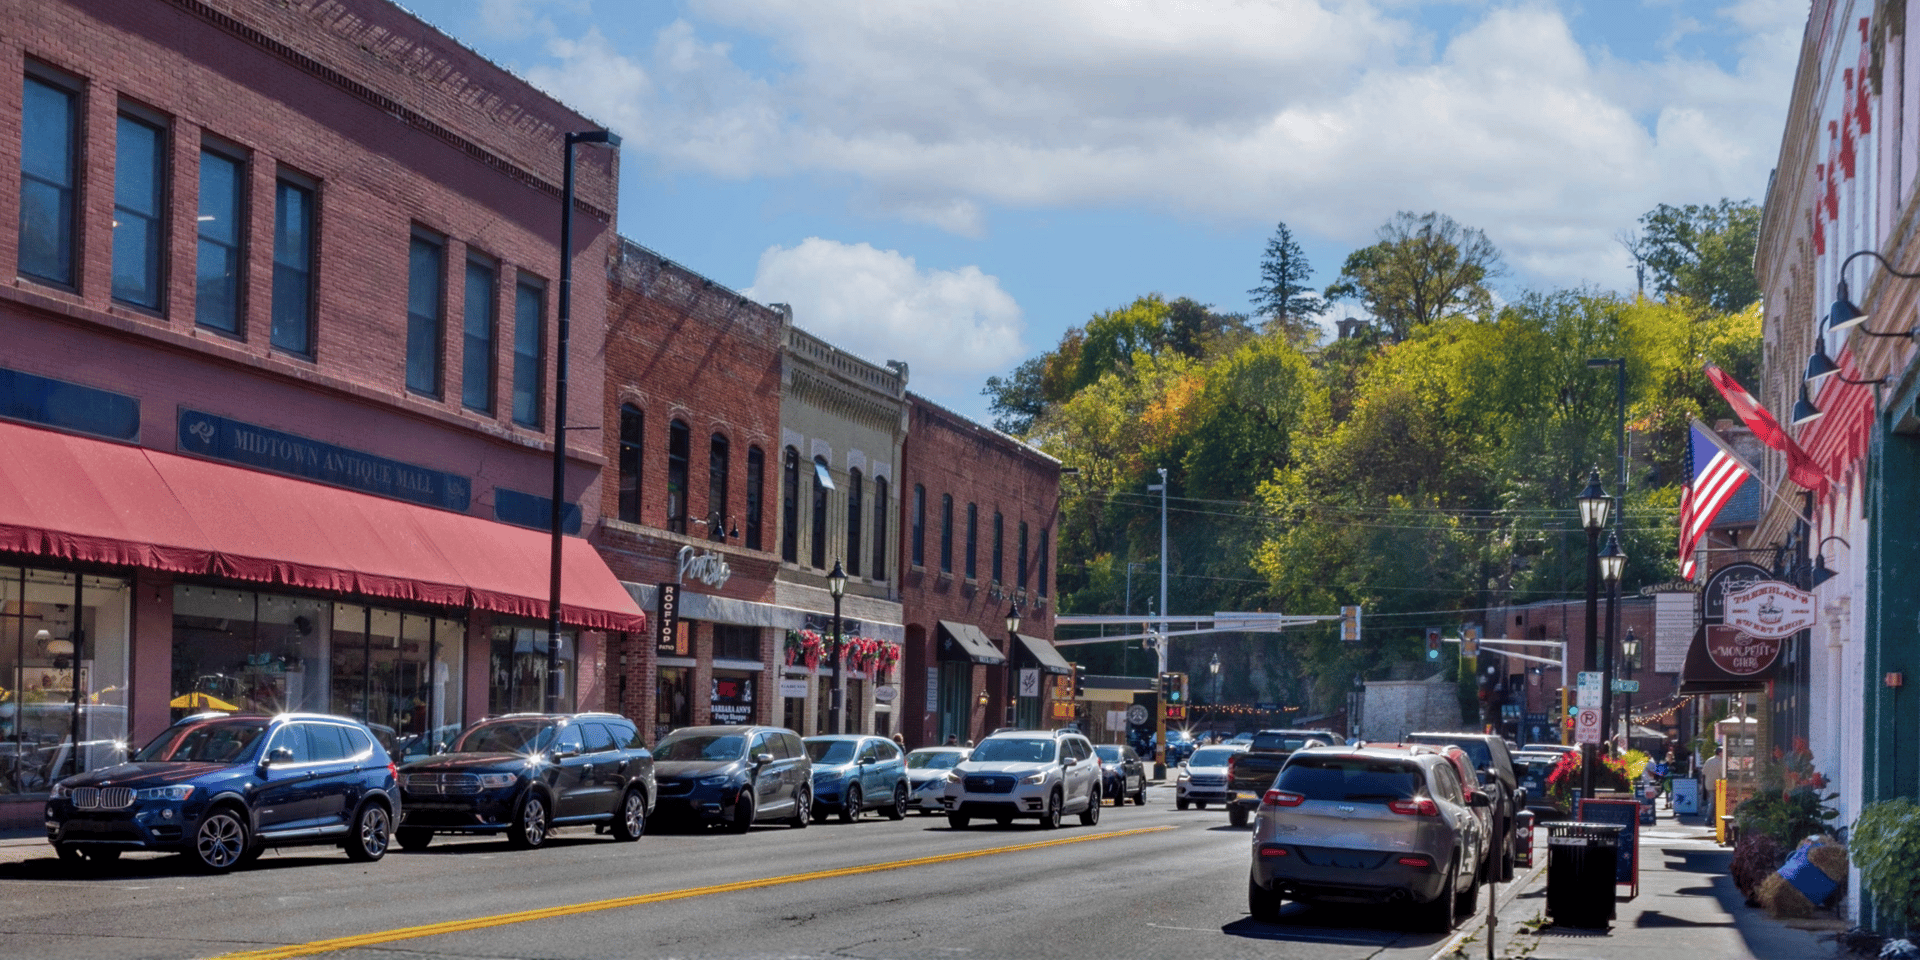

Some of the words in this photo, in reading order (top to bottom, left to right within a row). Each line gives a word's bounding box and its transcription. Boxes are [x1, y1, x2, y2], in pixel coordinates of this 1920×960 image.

[234, 429, 318, 466] MIDTOWN
[323, 452, 392, 484] ANTIQUE
[396, 469, 434, 494] MALL
[1640, 582, 1673, 595] GRAND
[1733, 586, 1809, 605] TREMBLAY'S
[663, 586, 674, 643] ROOFTOP
[1735, 618, 1774, 633] SWEET
[1777, 618, 1806, 633] SHOP
[1717, 645, 1742, 657] MON
[1744, 643, 1770, 657] PETIT
[711, 704, 735, 713] BARBARA
[736, 705, 751, 714] ANN'S
[1337, 804, 1354, 813] Jeep
